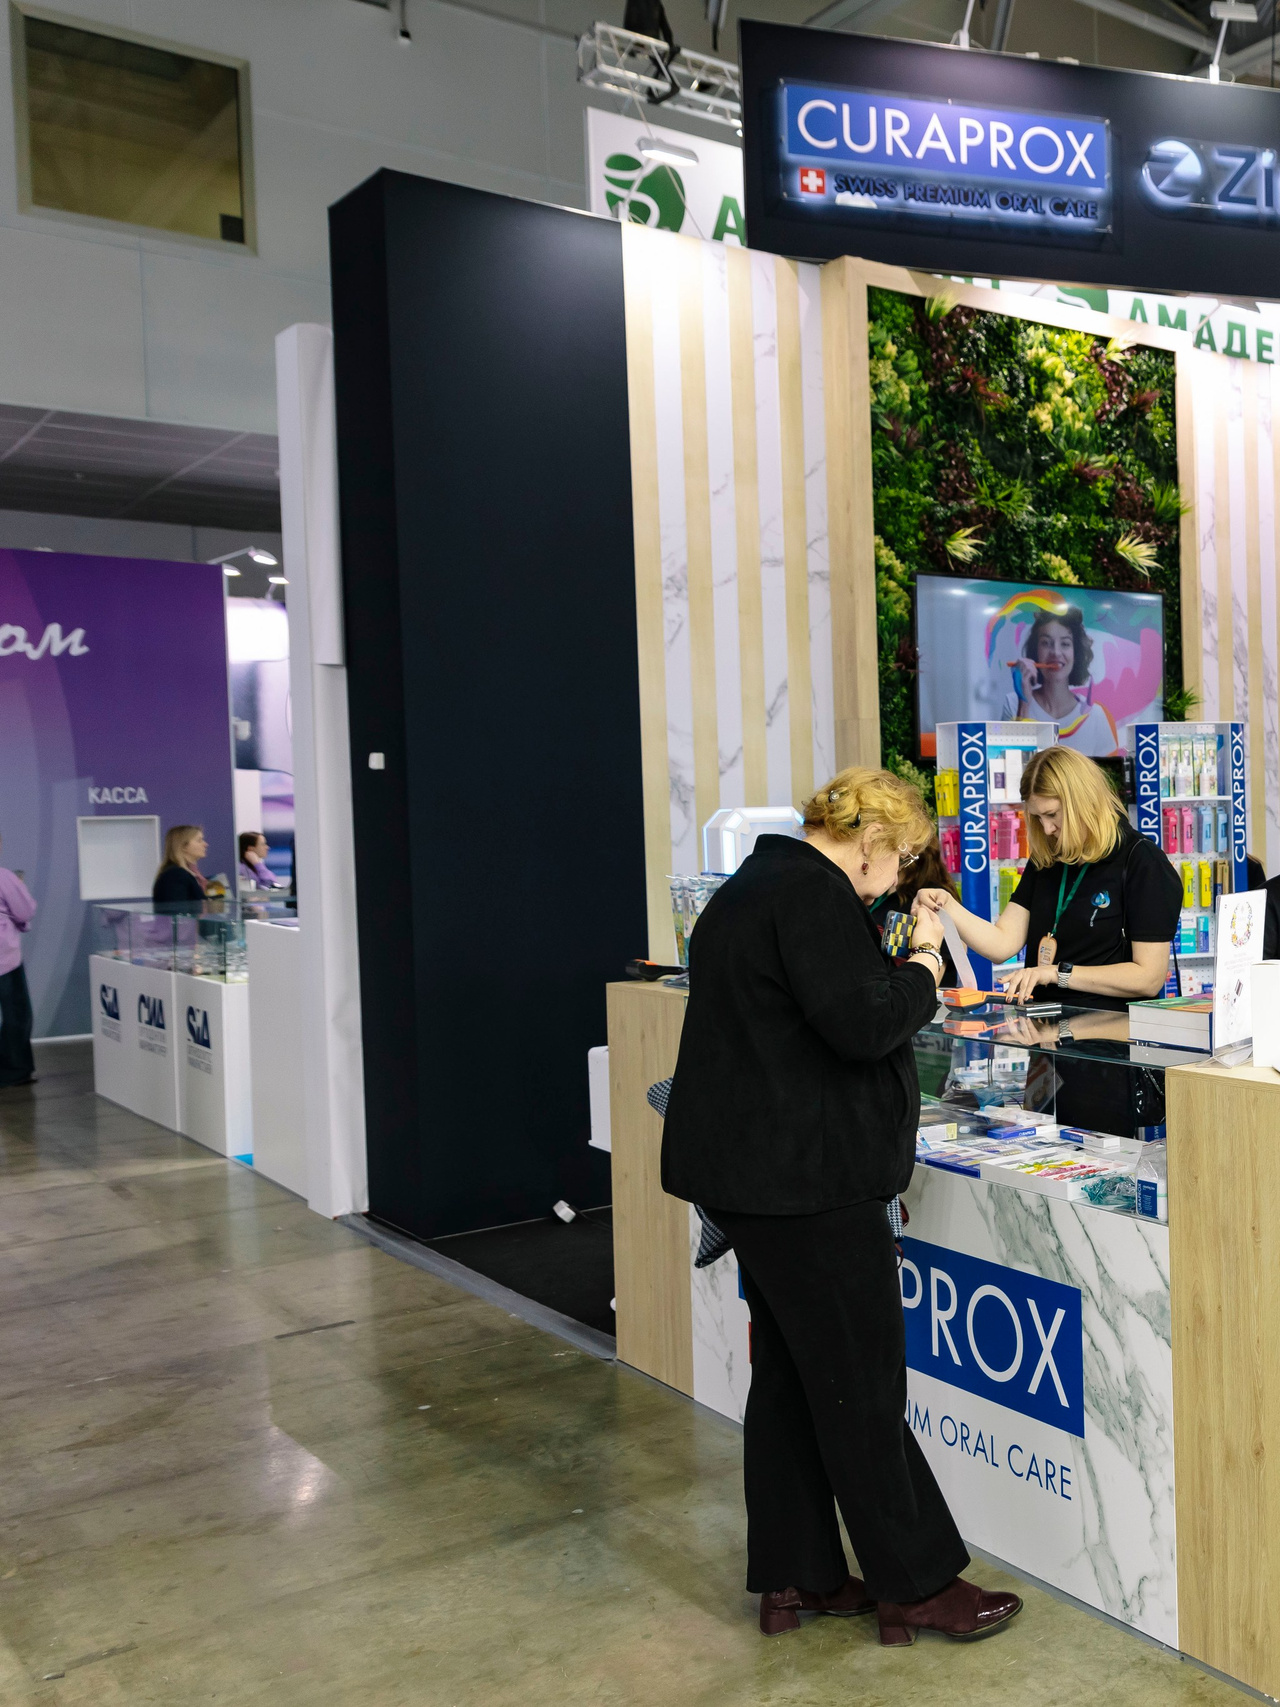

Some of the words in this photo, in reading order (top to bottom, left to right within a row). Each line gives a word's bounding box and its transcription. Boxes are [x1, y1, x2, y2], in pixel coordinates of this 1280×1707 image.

[797, 99, 1097, 179] CURAPROX
[834, 173, 898, 199] SWISS
[903, 183, 992, 209] PREMIUM
[995, 192, 1045, 215] ORAL
[1050, 197, 1098, 220] CARE
[88, 786, 149, 804] КАССА
[961, 731, 987, 873] CURAPROX
[1138, 731, 1159, 845] URAPROX
[1232, 731, 1246, 863] CURAPROX
[897, 1256, 1070, 1408] PROX
[940, 1415, 1000, 1469] ORAL
[1007, 1444, 1073, 1501] CARE
